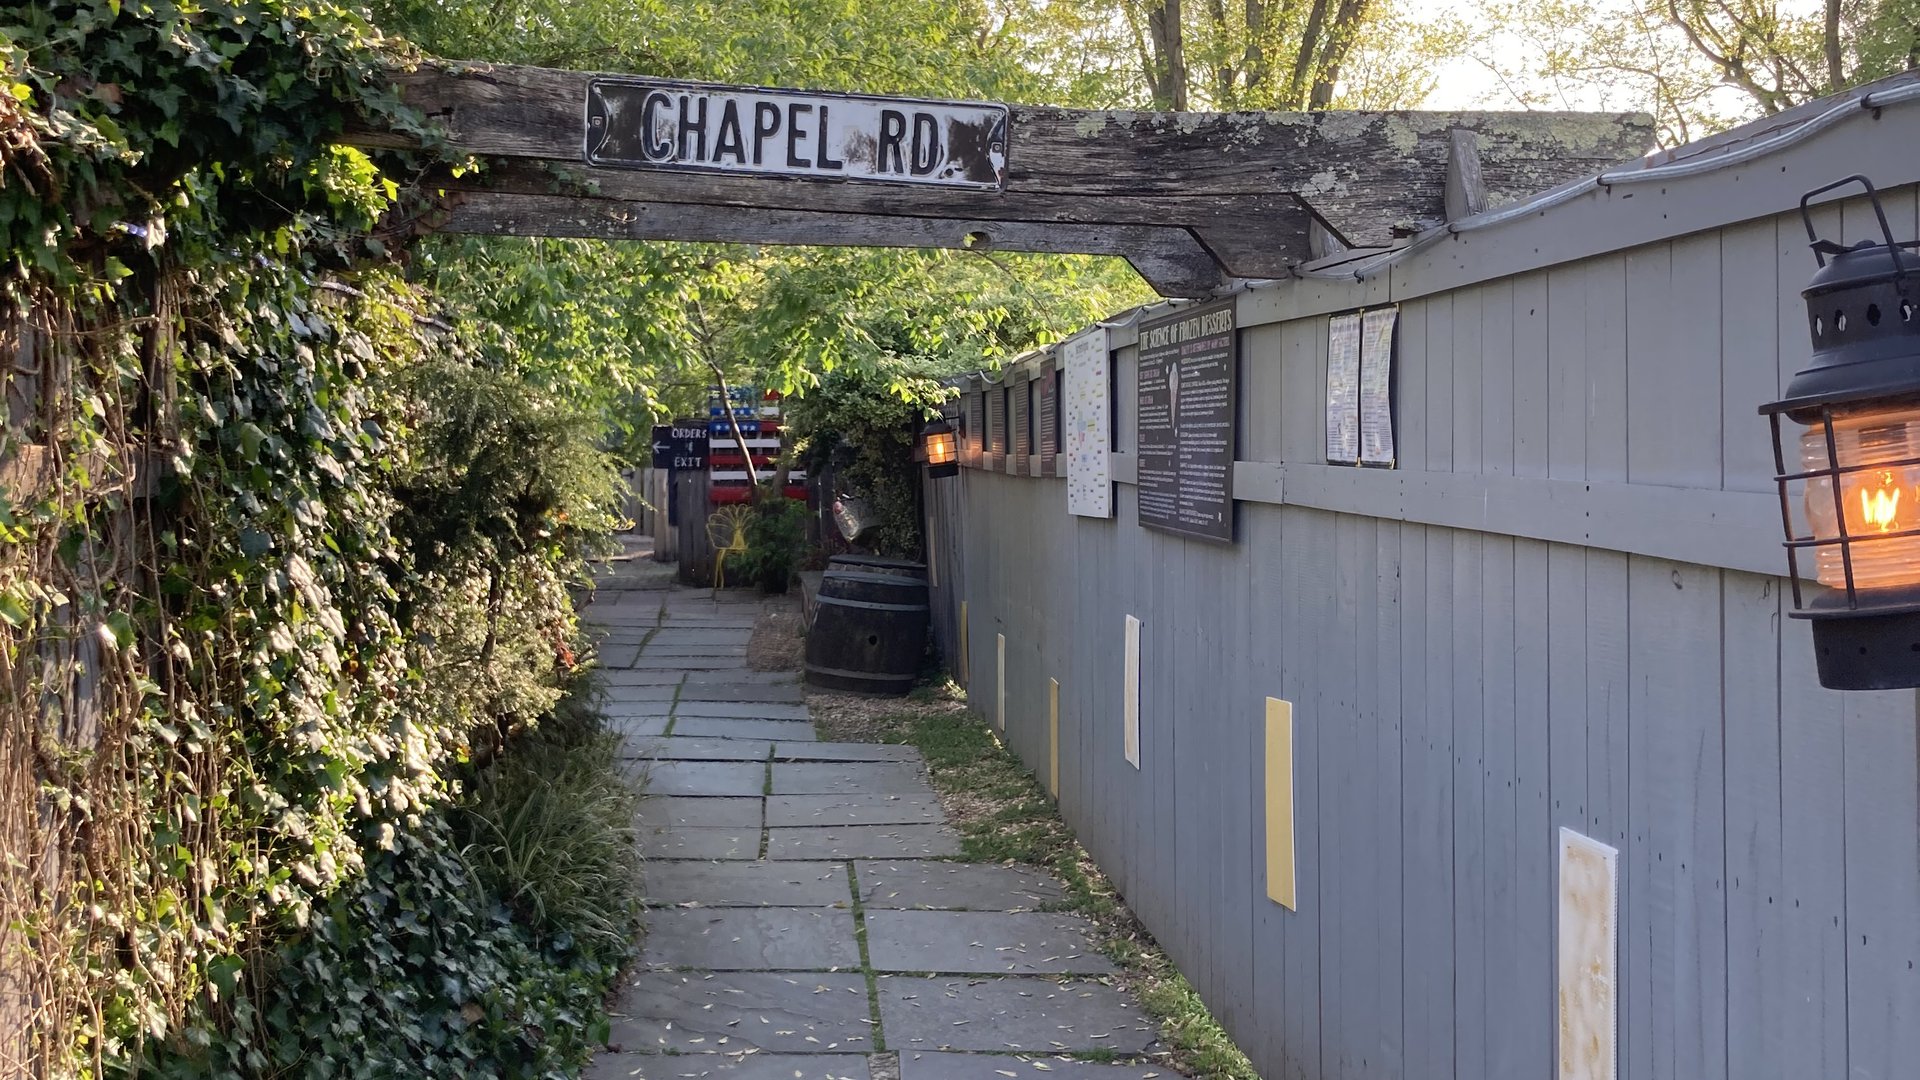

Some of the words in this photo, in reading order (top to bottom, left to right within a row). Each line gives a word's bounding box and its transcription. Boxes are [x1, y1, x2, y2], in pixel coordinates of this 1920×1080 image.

[641, 90, 842, 170] CHAPEL
[1140, 332, 1149, 351] THE
[1150, 325, 1169, 348] SCIENCE
[1171, 324, 1178, 343] OF
[1201, 309, 1232, 336] DESSERTS
[672, 429, 707, 439] ORDERS
[674, 457, 702, 467] EXIT
